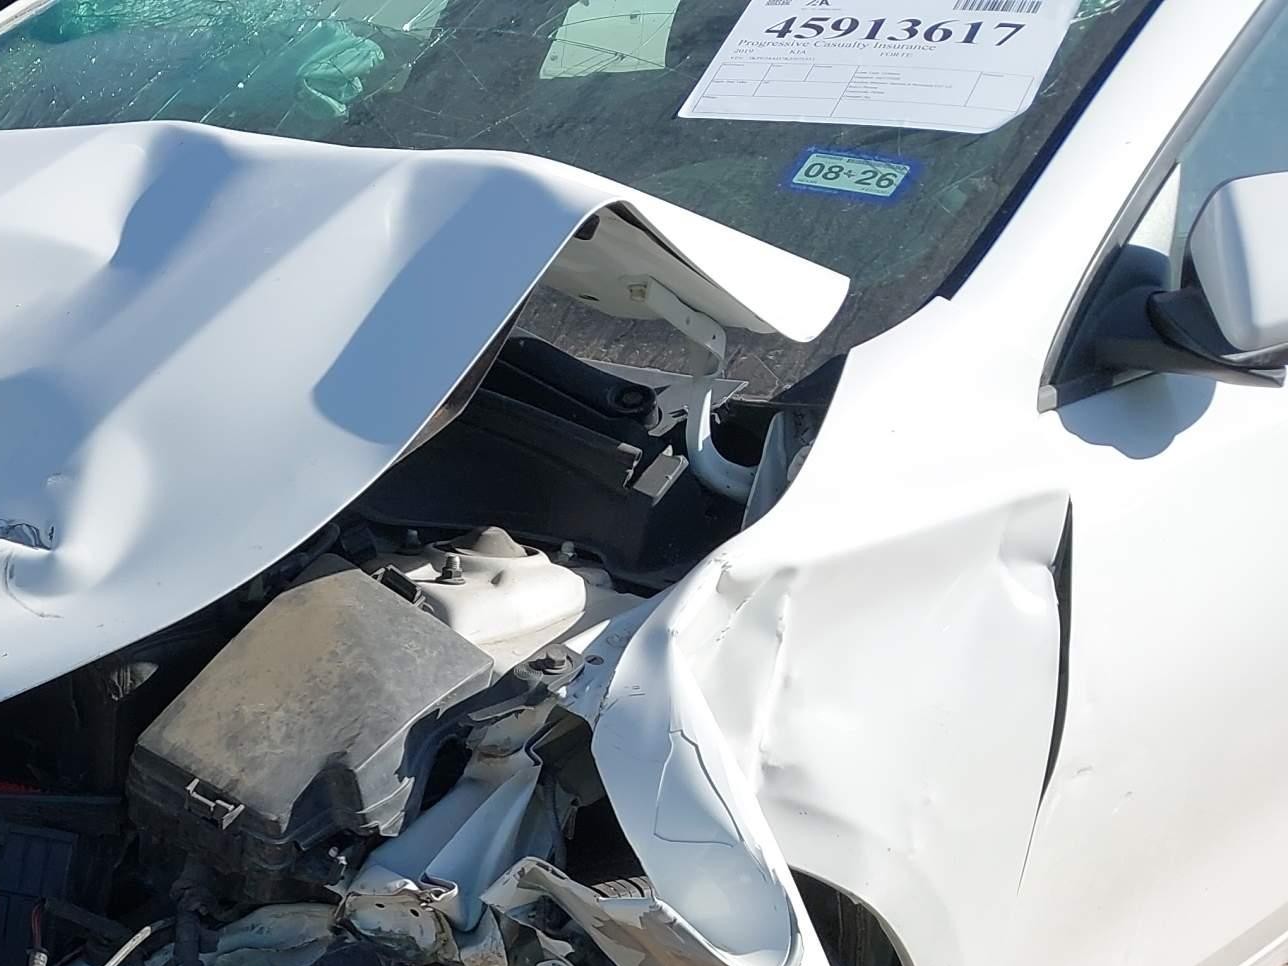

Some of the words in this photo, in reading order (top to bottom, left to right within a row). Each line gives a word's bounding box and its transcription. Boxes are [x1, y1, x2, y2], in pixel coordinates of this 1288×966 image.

[764, 15, 1026, 47] 45913617
[737, 39, 810, 48] Progressive
[813, 41, 870, 50] Casualty
[873, 42, 937, 51] Insurance
[804, 162, 845, 181] 08
[854, 169, 898, 189] 26
